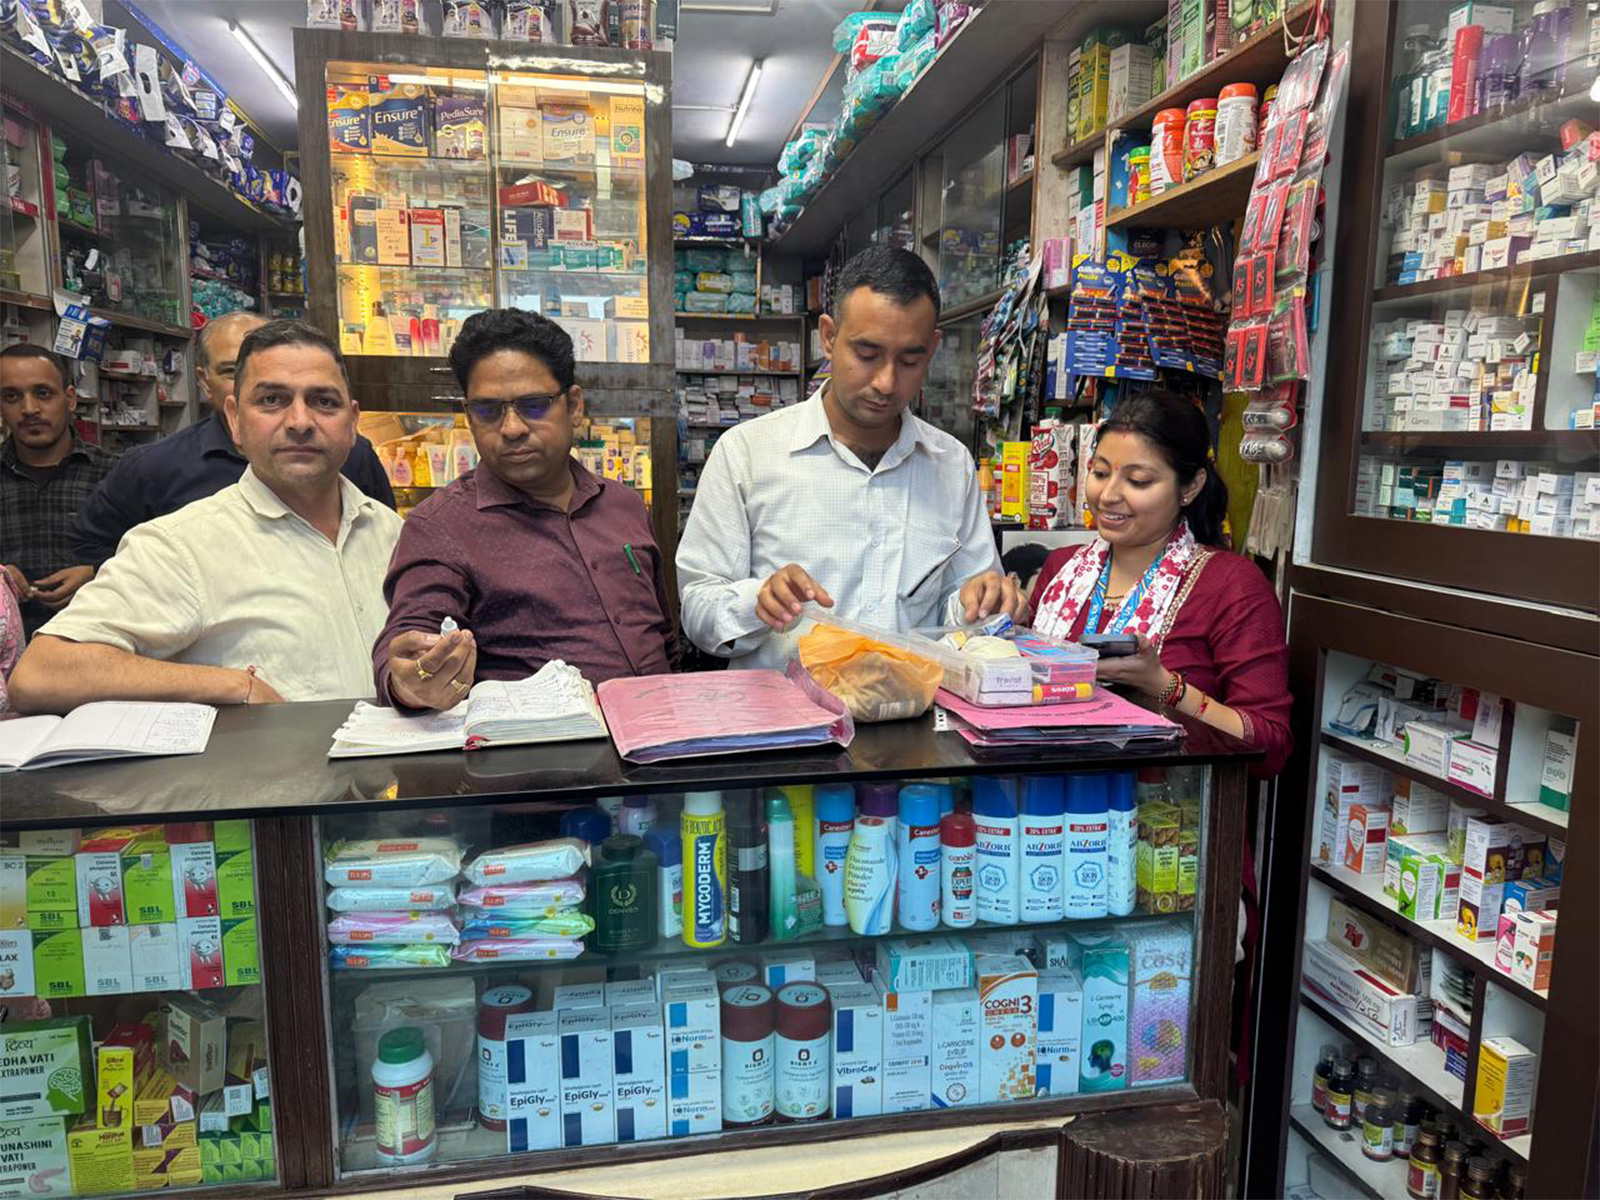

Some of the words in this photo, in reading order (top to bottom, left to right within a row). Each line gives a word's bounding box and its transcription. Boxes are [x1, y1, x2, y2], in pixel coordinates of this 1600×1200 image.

[375, 110, 418, 124] Ensure
[440, 107, 484, 120] PediaSure
[551, 127, 587, 138] Ensure
[1026, 842, 1062, 851] ABZORB
[1071, 839, 1107, 848] ABZORB
[4, 862, 18, 870] BC
[698, 842, 711, 924] MYCODERM
[231, 901, 254, 909] SBL
[139, 906, 162, 914] SBL
[40, 913, 63, 921] SBL
[237, 967, 259, 976] SBL
[97, 978, 120, 986] SBL
[145, 975, 168, 983] SBL
[49, 981, 73, 989] SBL
[985, 998, 1019, 1010] COGNI
[1020, 995, 1032, 1014] 3
[947, 1048, 967, 1056] SYRUP
[30, 1053, 55, 1064] VATI
[836, 1065, 877, 1077] VibroCar
[564, 1090, 600, 1102] EpiGly
[617, 1086, 651, 1097] EpiGly
[510, 1095, 545, 1107] EpiGly
[0, 1153, 24, 1162] VATI
